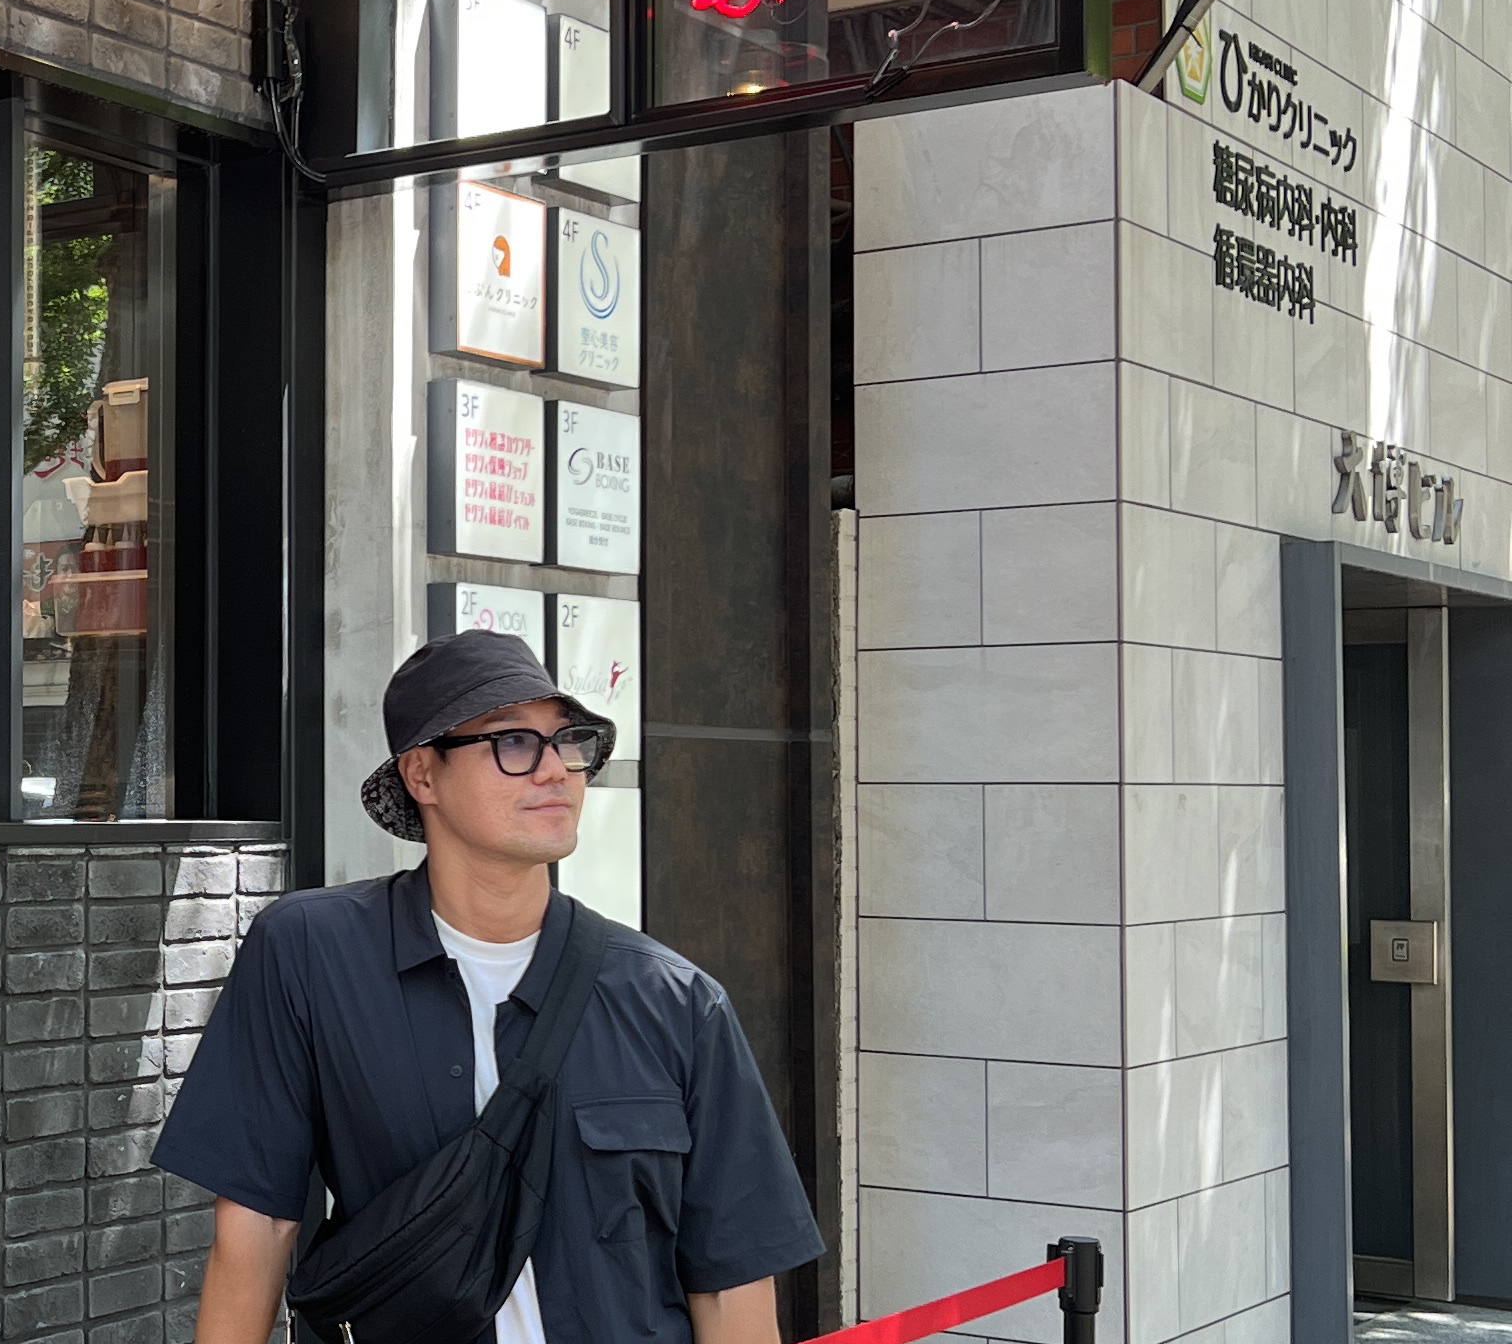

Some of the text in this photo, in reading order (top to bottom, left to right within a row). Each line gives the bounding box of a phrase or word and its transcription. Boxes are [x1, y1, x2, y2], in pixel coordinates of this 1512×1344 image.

[564, 26, 581, 51] 4F
[1218, 28, 1358, 172] ひかりクリニック
[562, 219, 579, 243] 4F
[1213, 222, 1316, 324] 循環器内科
[461, 393, 479, 419] 3F
[562, 410, 579, 434] 3F
[595, 451, 631, 475] BASE
[594, 473, 631, 494] BOXING
[461, 590, 478, 617] 2F
[497, 610, 528, 634] YOGA
[561, 604, 579, 629] 2F
